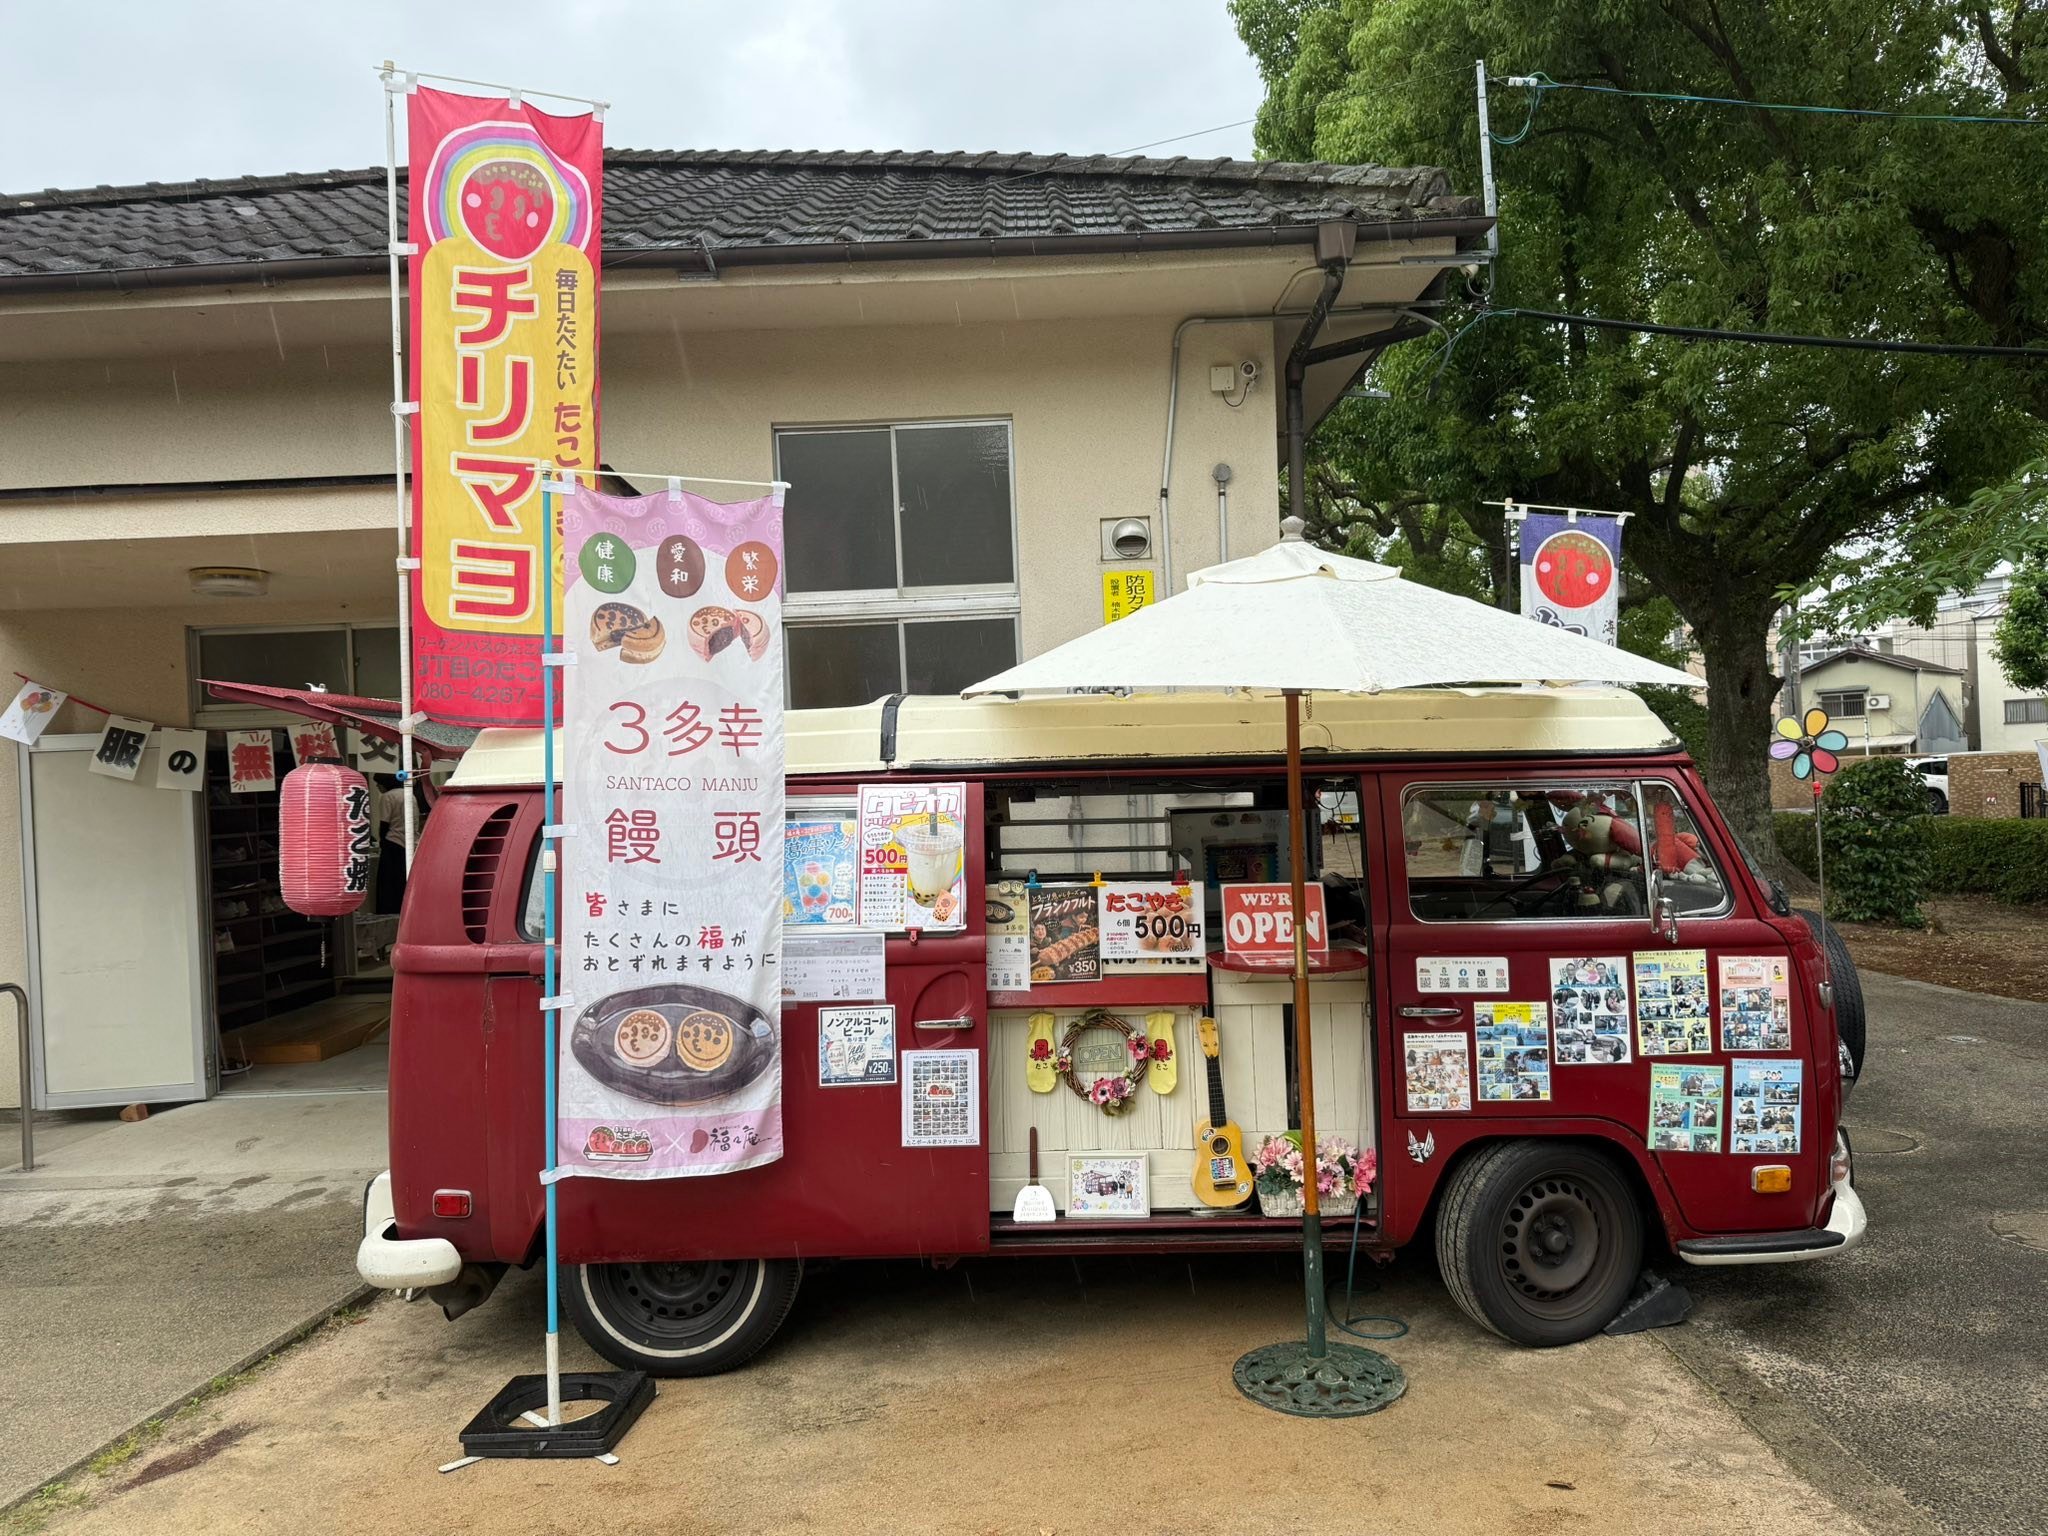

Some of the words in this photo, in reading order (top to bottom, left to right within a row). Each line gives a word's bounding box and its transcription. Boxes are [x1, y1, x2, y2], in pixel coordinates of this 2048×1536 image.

[556, 268, 577, 390] 毎日たべたい
[451, 263, 540, 622] チリマヨ
[595, 540, 615, 583] 健康
[670, 542, 688, 584] 愛和
[742, 551, 759, 593] 繁栄
[604, 701, 763, 757] 3多幸
[96, 727, 146, 769] 服
[168, 750, 197, 774] の
[232, 743, 273, 782] 無
[606, 776, 691, 791] SANTACO
[702, 777, 758, 792] MANJU
[866, 790, 959, 817] タピオカ
[865, 816, 902, 827] ドリンク
[865, 848, 908, 864] 500円
[585, 891, 679, 917] 皆さまに
[1032, 896, 1096, 920] フランクフルト
[1106, 892, 1184, 912] たこやき
[1240, 892, 1293, 907] WE'R
[583, 926, 747, 950] たくさんの福が
[1116, 919, 1131, 927] 6個
[1135, 915, 1201, 938] 500円
[583, 951, 776, 972] おとずれますように
[1069, 960, 1097, 973] ¥350
[827, 1016, 889, 1028] ノンアルコール
[843, 1027, 874, 1037] ビール
[1081, 1043, 1122, 1061] OPEN
[868, 1062, 889, 1073] ¥250
